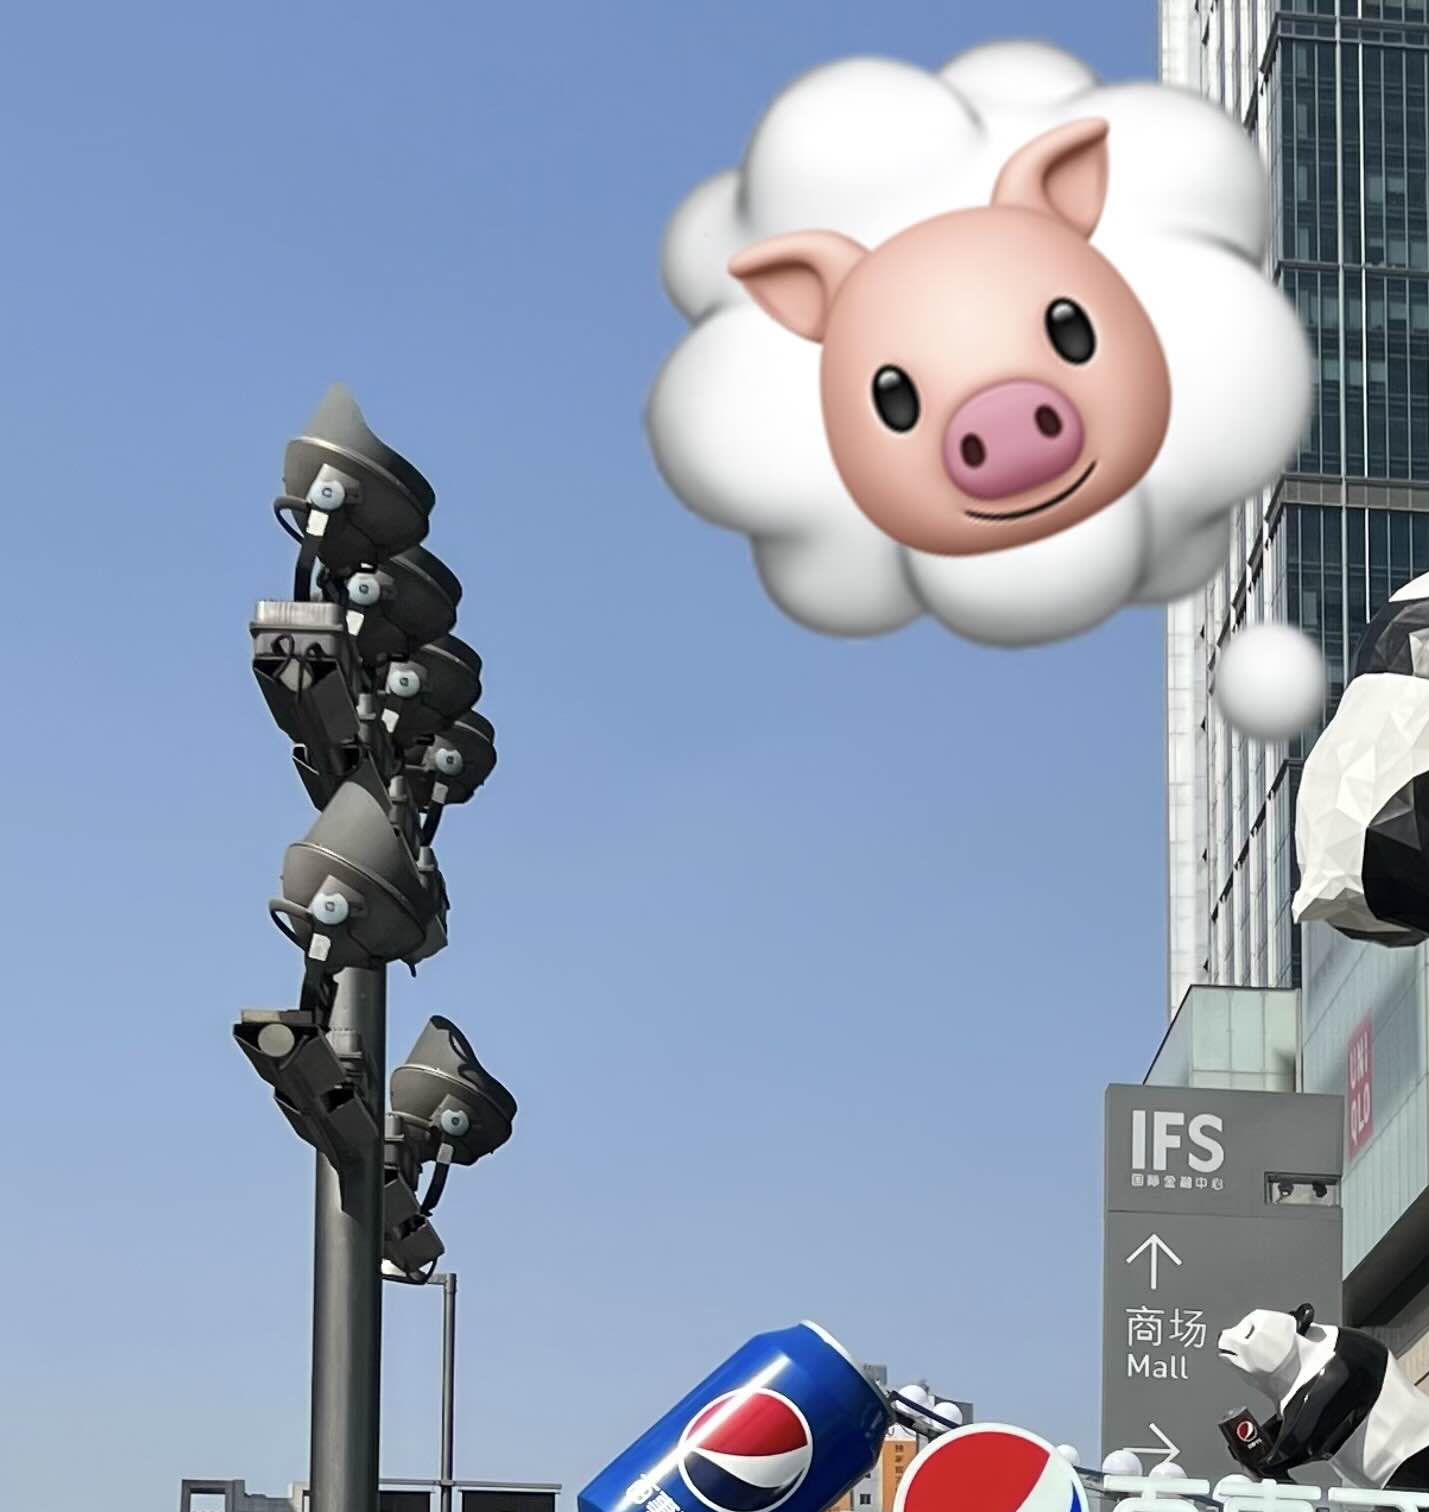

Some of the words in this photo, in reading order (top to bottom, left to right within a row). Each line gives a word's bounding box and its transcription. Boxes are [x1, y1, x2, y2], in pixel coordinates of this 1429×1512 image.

[1131, 1110, 1225, 1173] IFS
[1125, 1305, 1207, 1349] 商场
[1127, 1353, 1189, 1380] Mall
